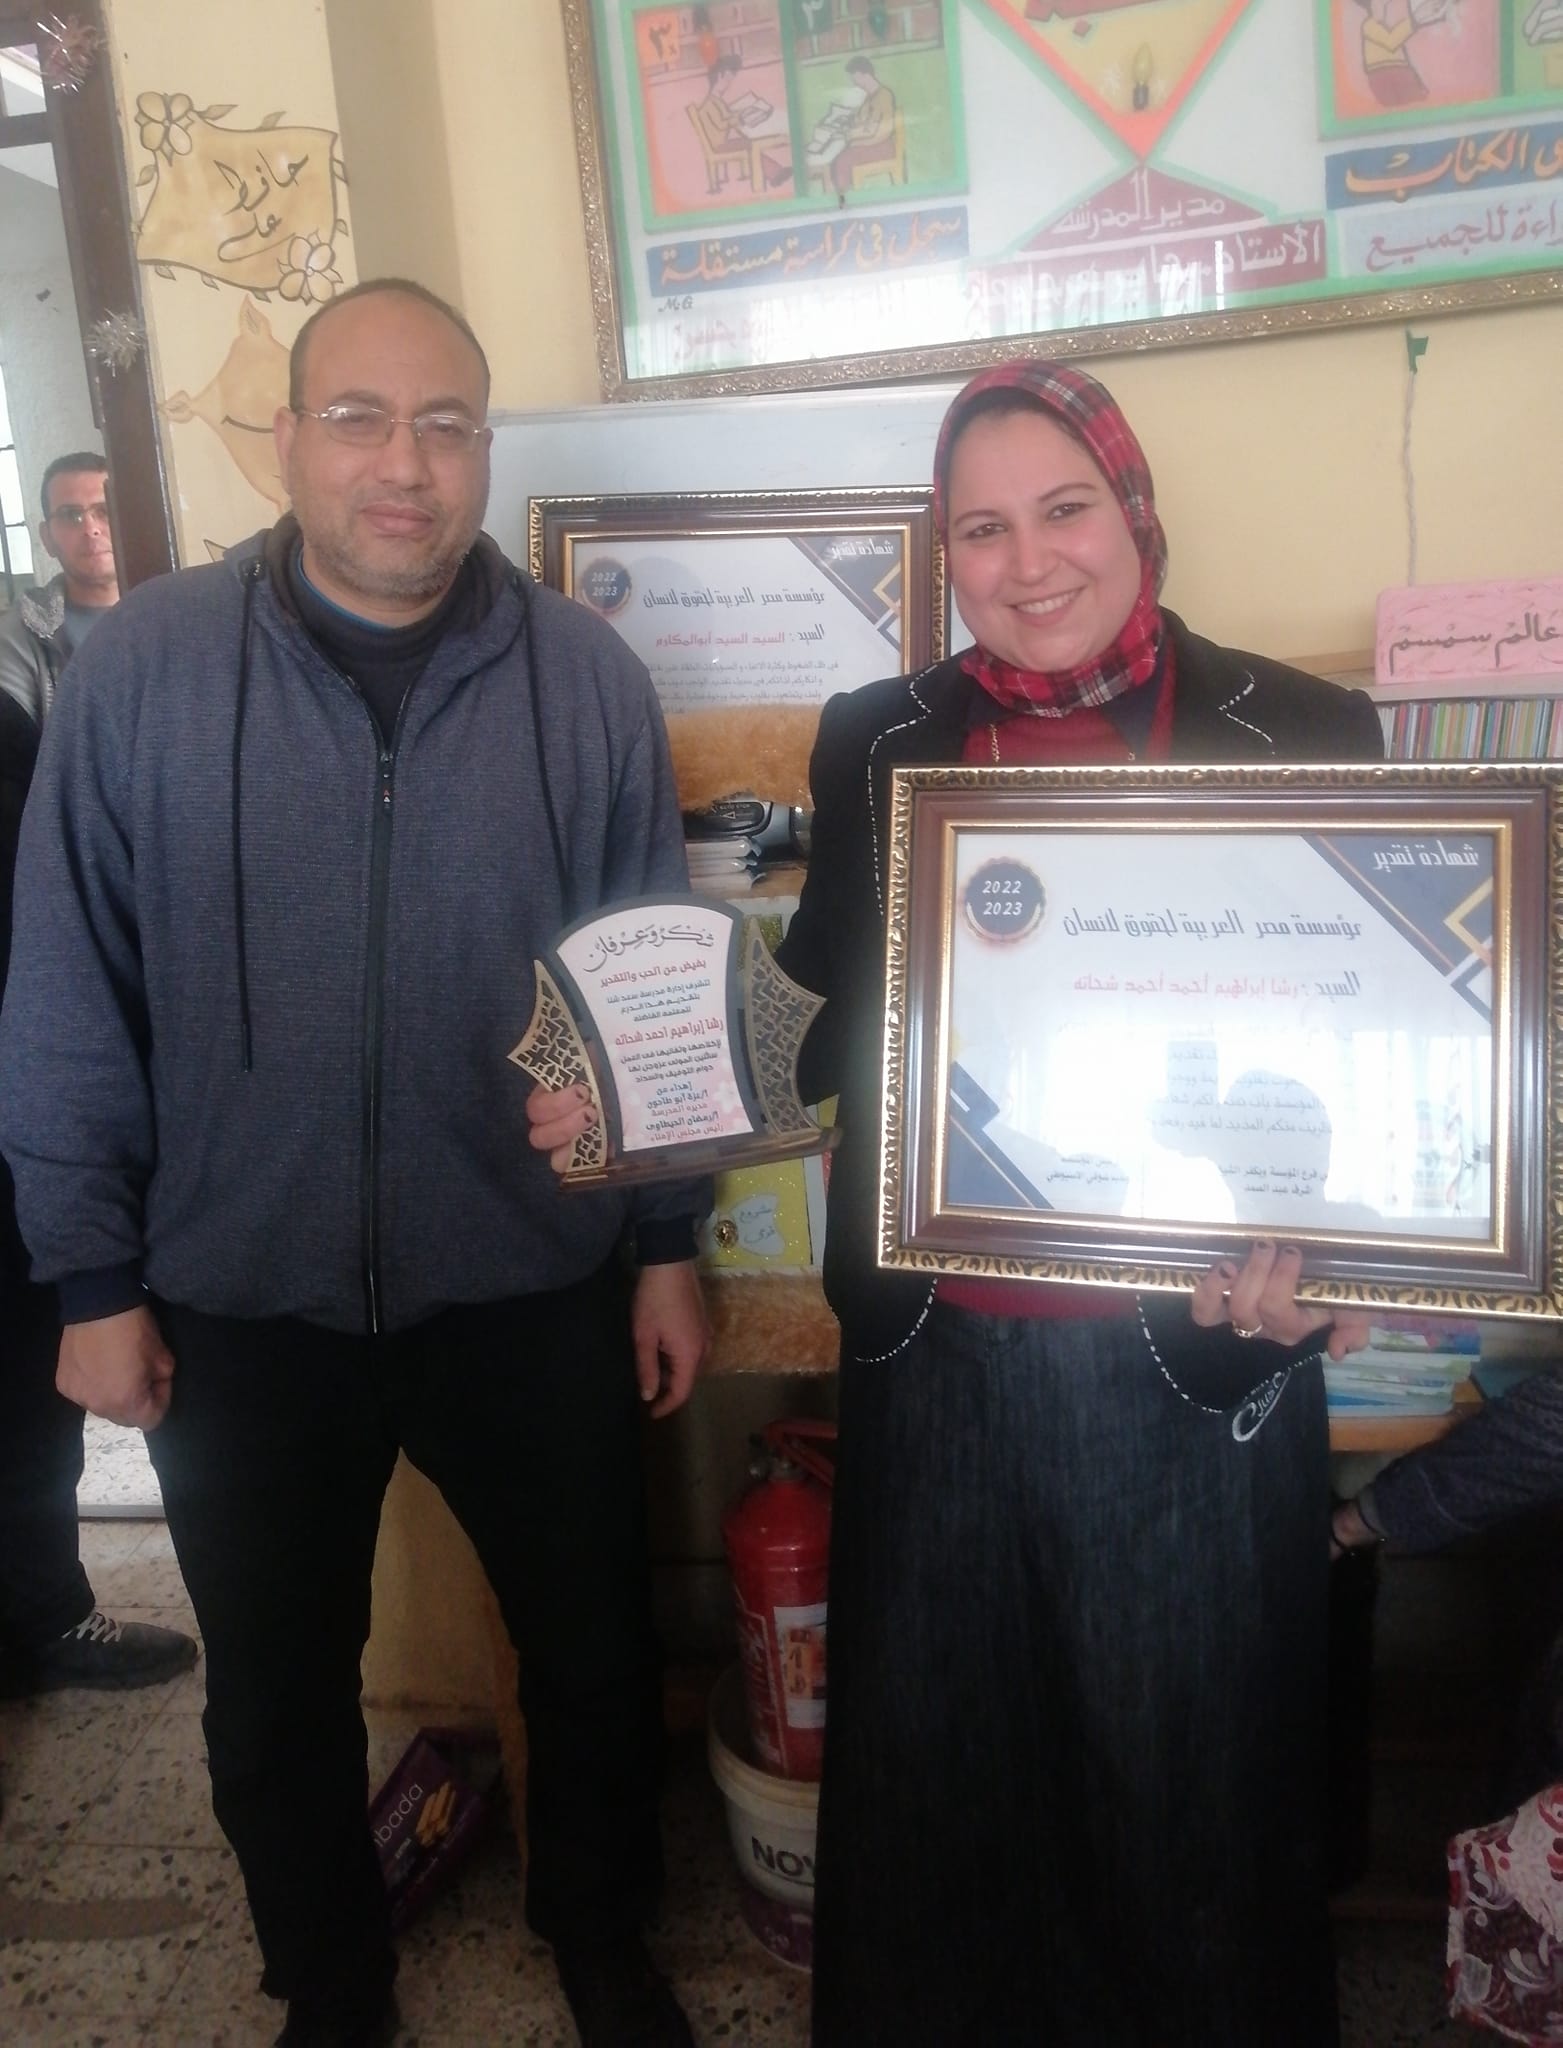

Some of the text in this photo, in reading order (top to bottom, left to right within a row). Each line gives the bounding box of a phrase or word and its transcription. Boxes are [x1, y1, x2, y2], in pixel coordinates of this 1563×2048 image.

[1140, 199, 1224, 231] مدير
[1366, 205, 1508, 272] للجميع
[856, 538, 893, 555] شهادة
[592, 572, 616, 582] 2022
[592, 586, 617, 596] 2023
[714, 586, 755, 609] العربية
[761, 592, 783, 607] مصر
[783, 588, 825, 606] مؤسسة
[716, 631, 748, 646] السيد
[751, 631, 785, 646] السيد
[798, 623, 825, 645] السيد
[1373, 839, 1479, 872] شهادة تقدير
[982, 880, 1021, 894] 2022
[983, 901, 1022, 916] 2023
[1124, 908, 1178, 938] لحقوق
[1179, 909, 1244, 941] العربية
[1256, 920, 1291, 939] مصر
[1290, 914, 1361, 941] مؤسسة
[600, 970, 637, 988] والتقدير
[640, 965, 661, 981] الحب
[664, 966, 677, 977] من
[1271, 976, 1298, 998] رشا
[1315, 970, 1361, 998] السيد
[705, 1016, 724, 1032] رشا
[656, 1088, 669, 1096] من
[374, 1783, 424, 1848] bada
